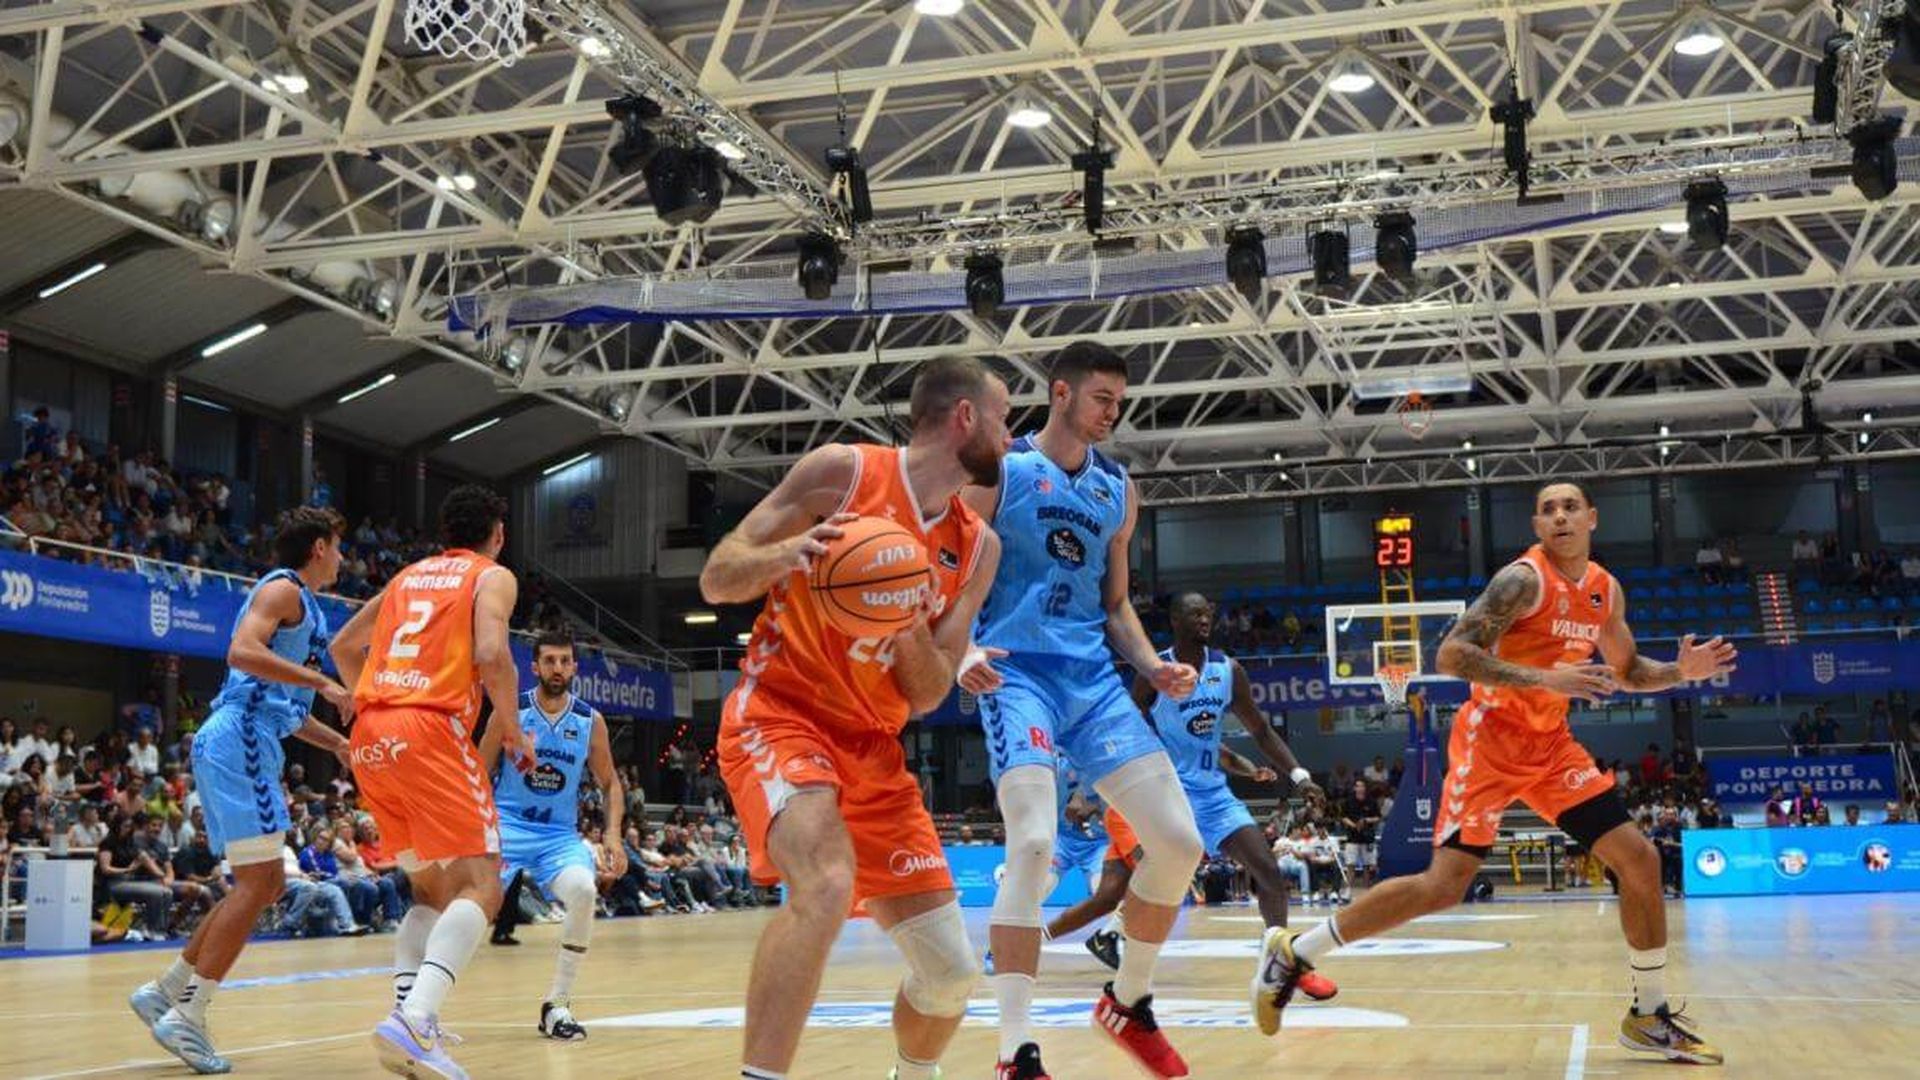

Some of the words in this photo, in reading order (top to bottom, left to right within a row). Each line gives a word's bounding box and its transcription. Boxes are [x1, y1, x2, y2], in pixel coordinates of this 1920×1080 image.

[1378, 538, 1411, 566] 23
[387, 600, 434, 658] 2
[571, 673, 656, 710] ontevedra
[1740, 764, 1856, 781] DEPORTE
